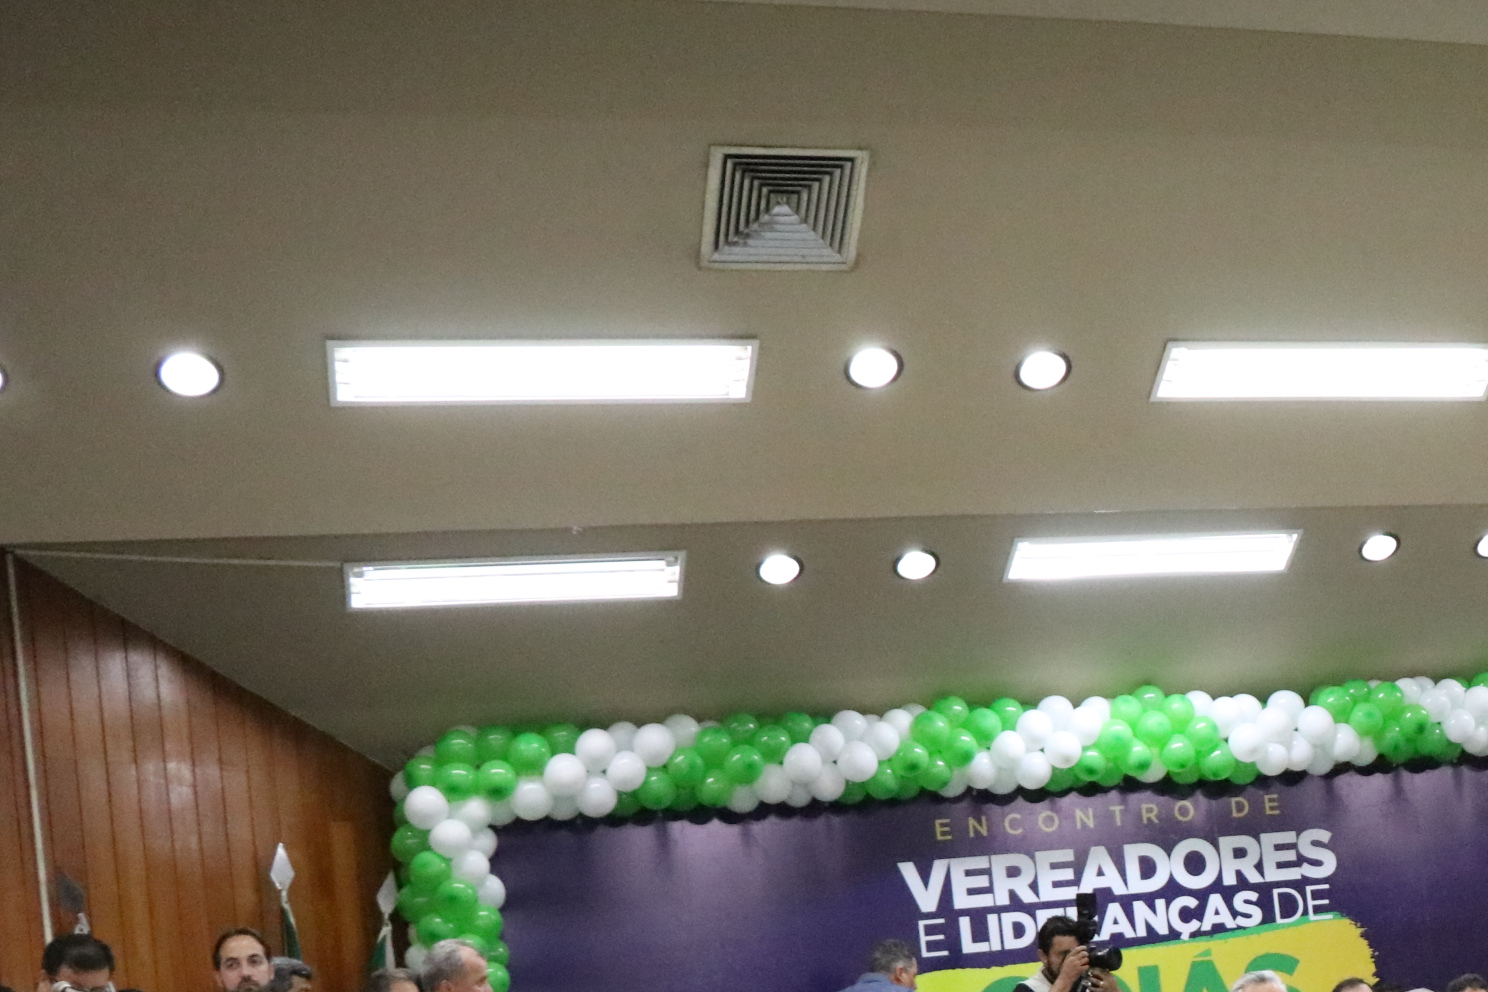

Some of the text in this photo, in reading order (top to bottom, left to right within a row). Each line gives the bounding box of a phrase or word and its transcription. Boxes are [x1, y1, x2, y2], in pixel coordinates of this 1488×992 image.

[934, 794, 1280, 841] ENCONTRO DE
[897, 828, 1337, 913] VEREADORES
[918, 884, 1334, 958] E LIDANÇAS DE
